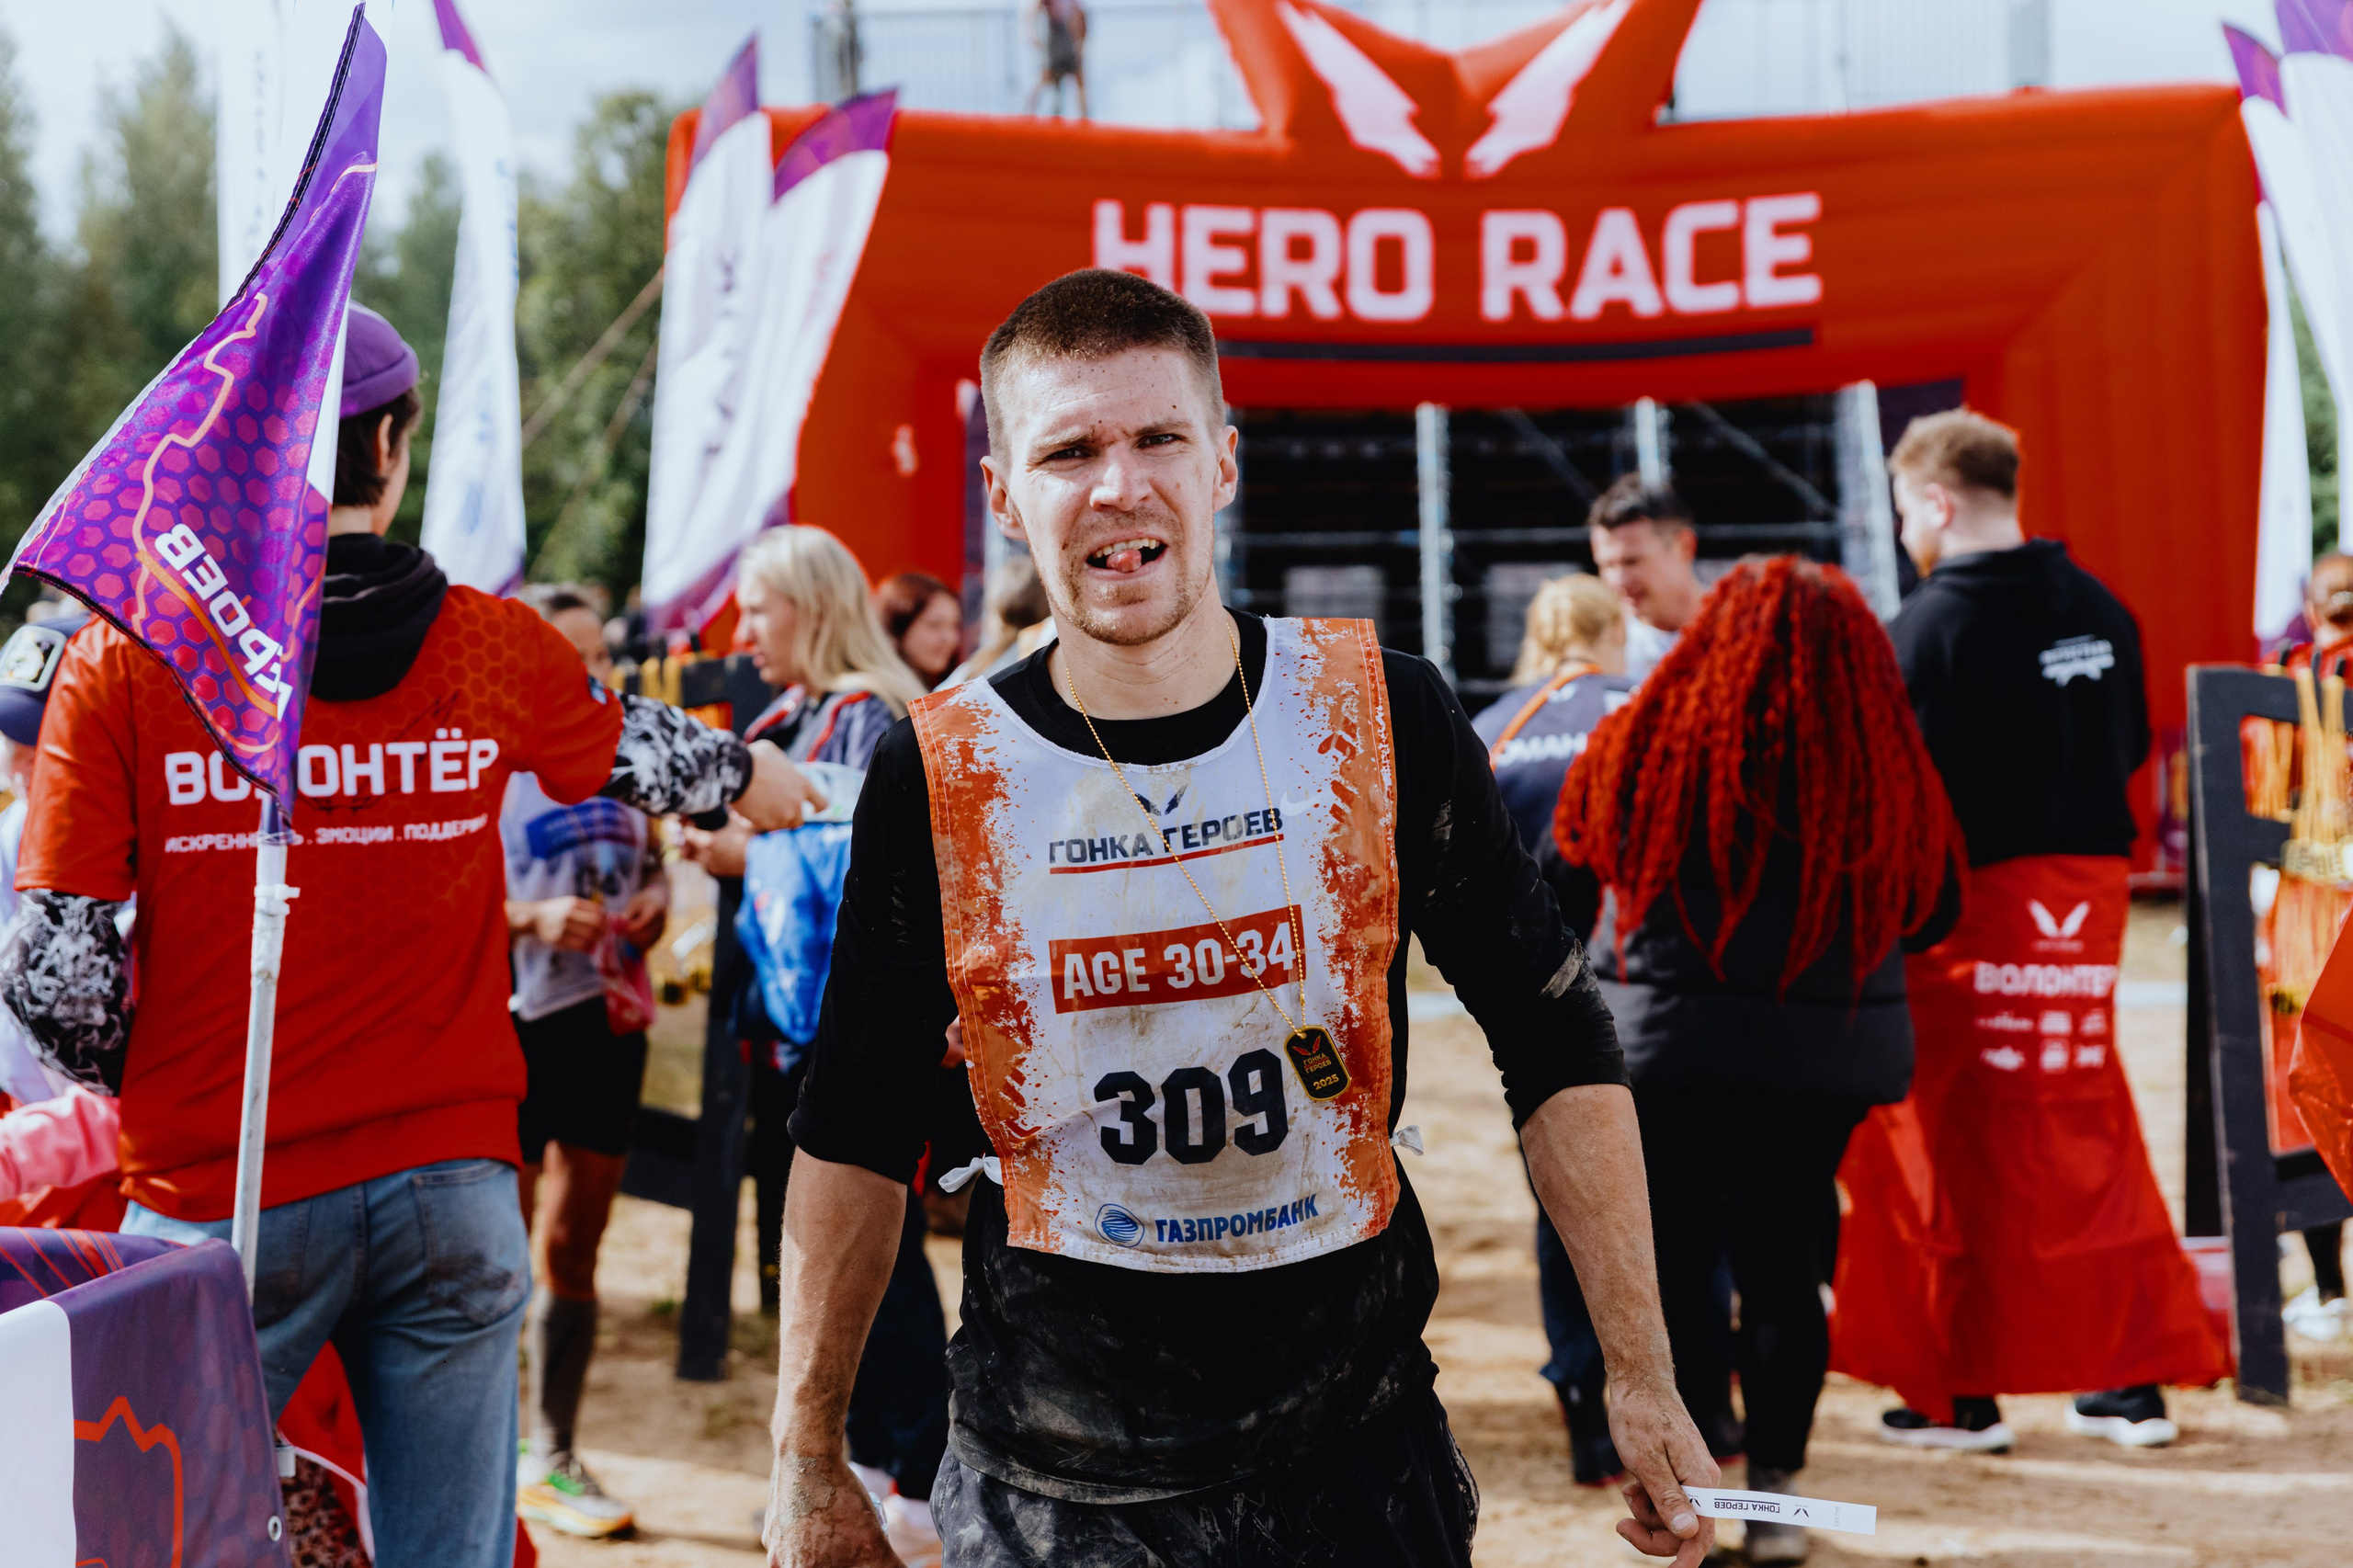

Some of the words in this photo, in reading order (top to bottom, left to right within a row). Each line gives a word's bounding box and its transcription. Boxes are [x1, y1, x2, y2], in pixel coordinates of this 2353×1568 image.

[1092, 198, 1434, 323] HERO
[1480, 192, 1824, 322] RACE
[165, 727, 499, 805] ВООНТЁР
[315, 825, 394, 846] ЭМОЦИИ
[1049, 831, 1154, 864] ГОНКА
[1162, 806, 1284, 853] ГЕРОЕВ
[1063, 948, 1151, 1000] AGE
[1163, 921, 1297, 990] 30-34
[1302, 1052, 1329, 1066] ГОНКА
[1305, 1059, 1332, 1074] ГЕРОЕВ
[1313, 1074, 1340, 1091] 2025
[1093, 1048, 1290, 1165] 309
[1154, 1193, 1320, 1244] ГАЗПРОМБАНК
[1713, 1500, 1749, 1512] ГЕРОЕВ
[1751, 1503, 1780, 1514] ГОНКА
